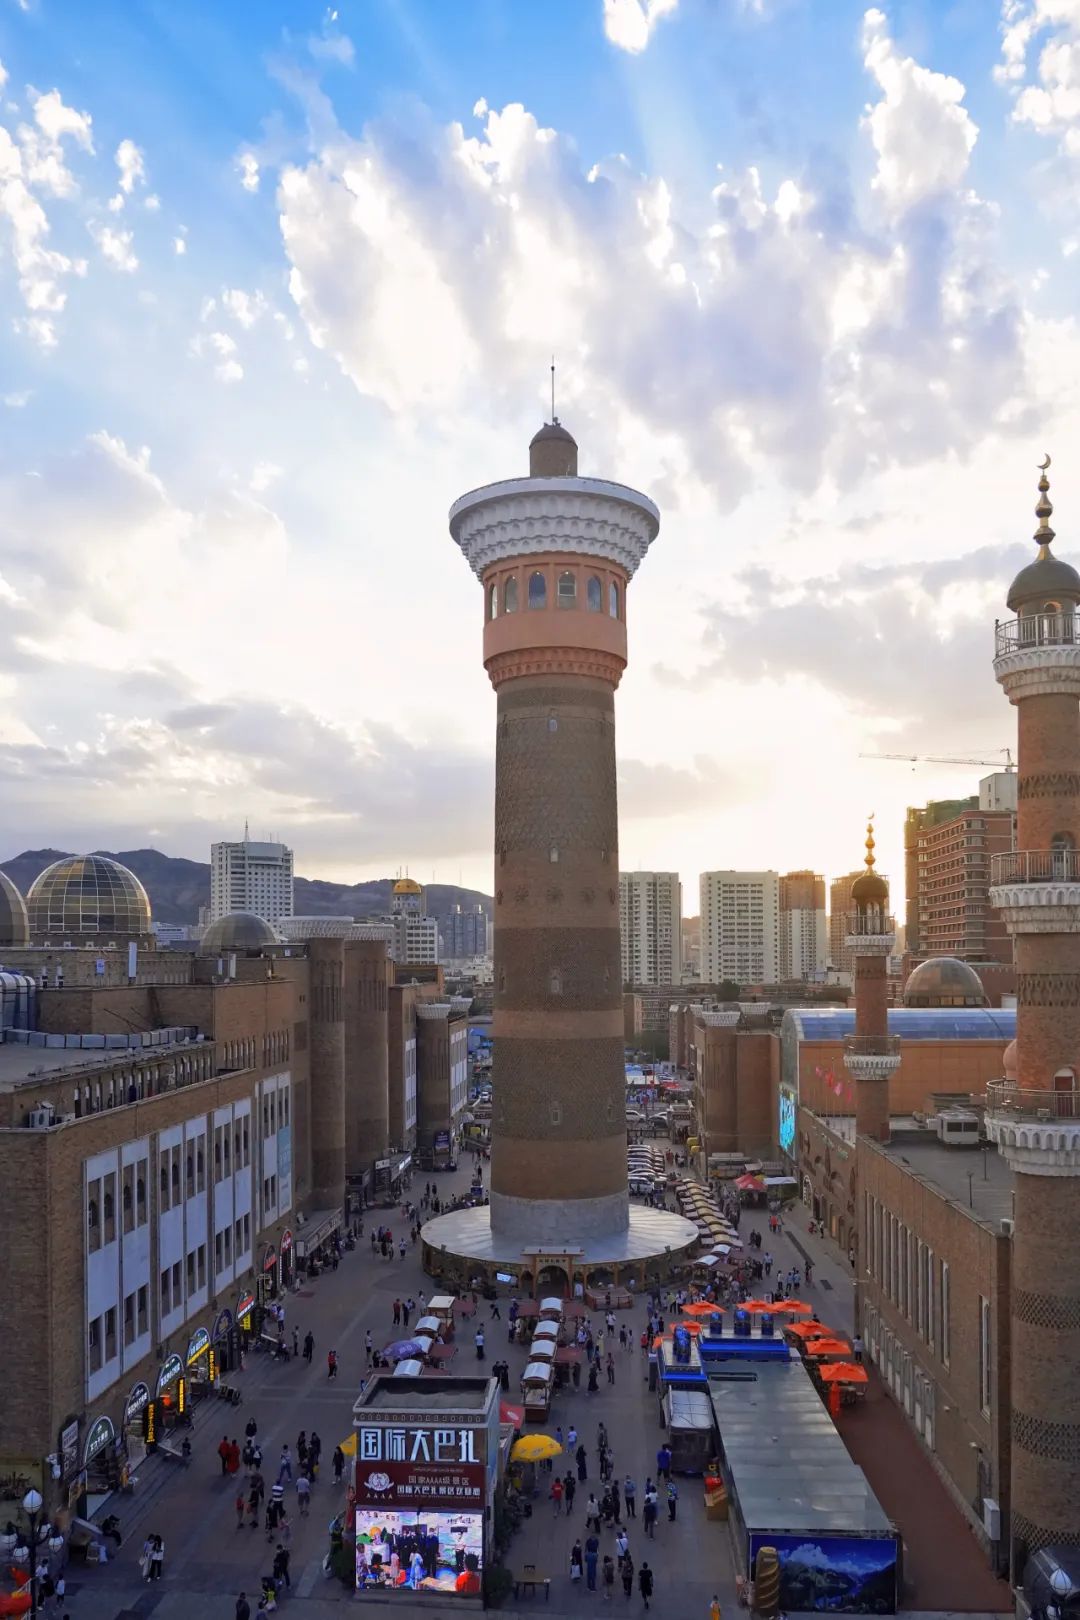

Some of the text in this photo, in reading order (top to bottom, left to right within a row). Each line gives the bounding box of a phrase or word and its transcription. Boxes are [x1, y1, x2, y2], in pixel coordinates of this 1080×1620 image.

[360, 1428, 480, 1462] 国际大巴扎
